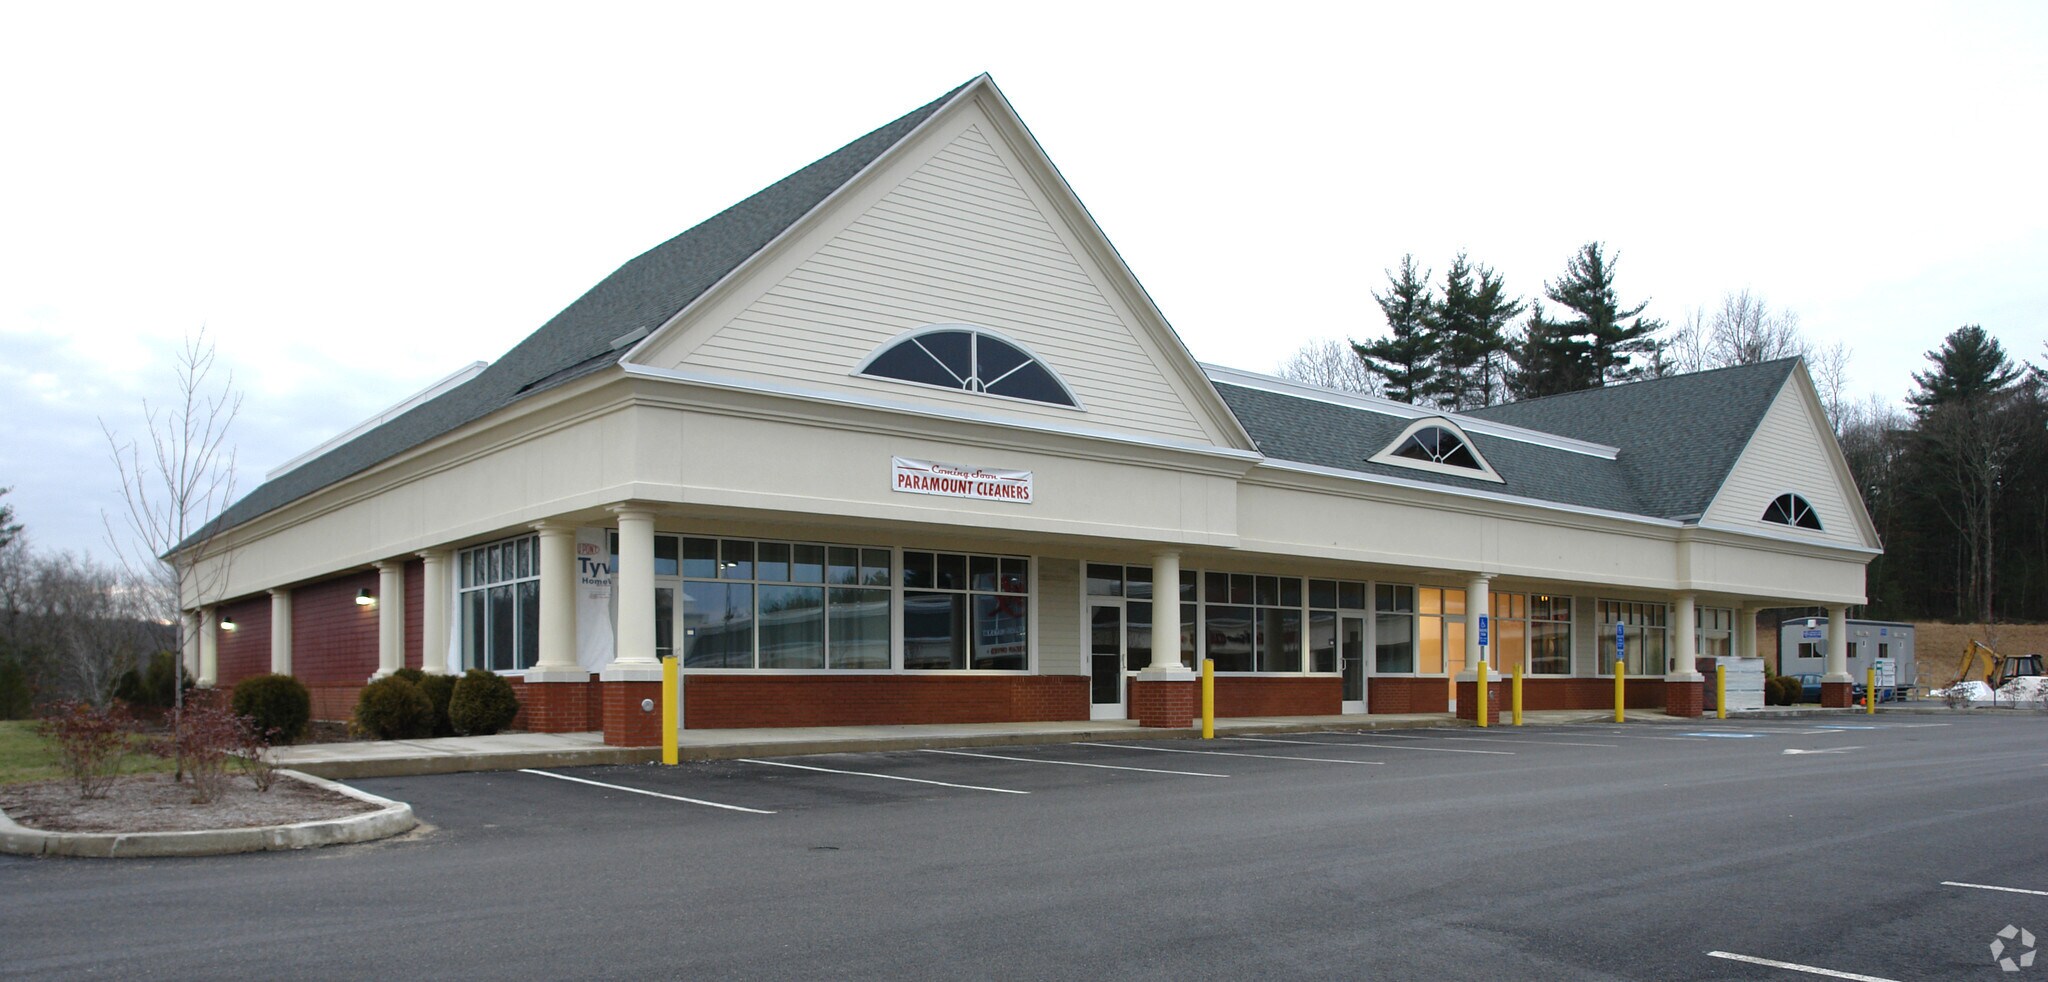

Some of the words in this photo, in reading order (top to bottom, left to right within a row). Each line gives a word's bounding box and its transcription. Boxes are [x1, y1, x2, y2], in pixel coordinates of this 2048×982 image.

[931, 464, 970, 479] Coming
[971, 469, 999, 480] Soon
[897, 473, 974, 495] PARAMOUNT
[976, 481, 1030, 500] CLEANERS
